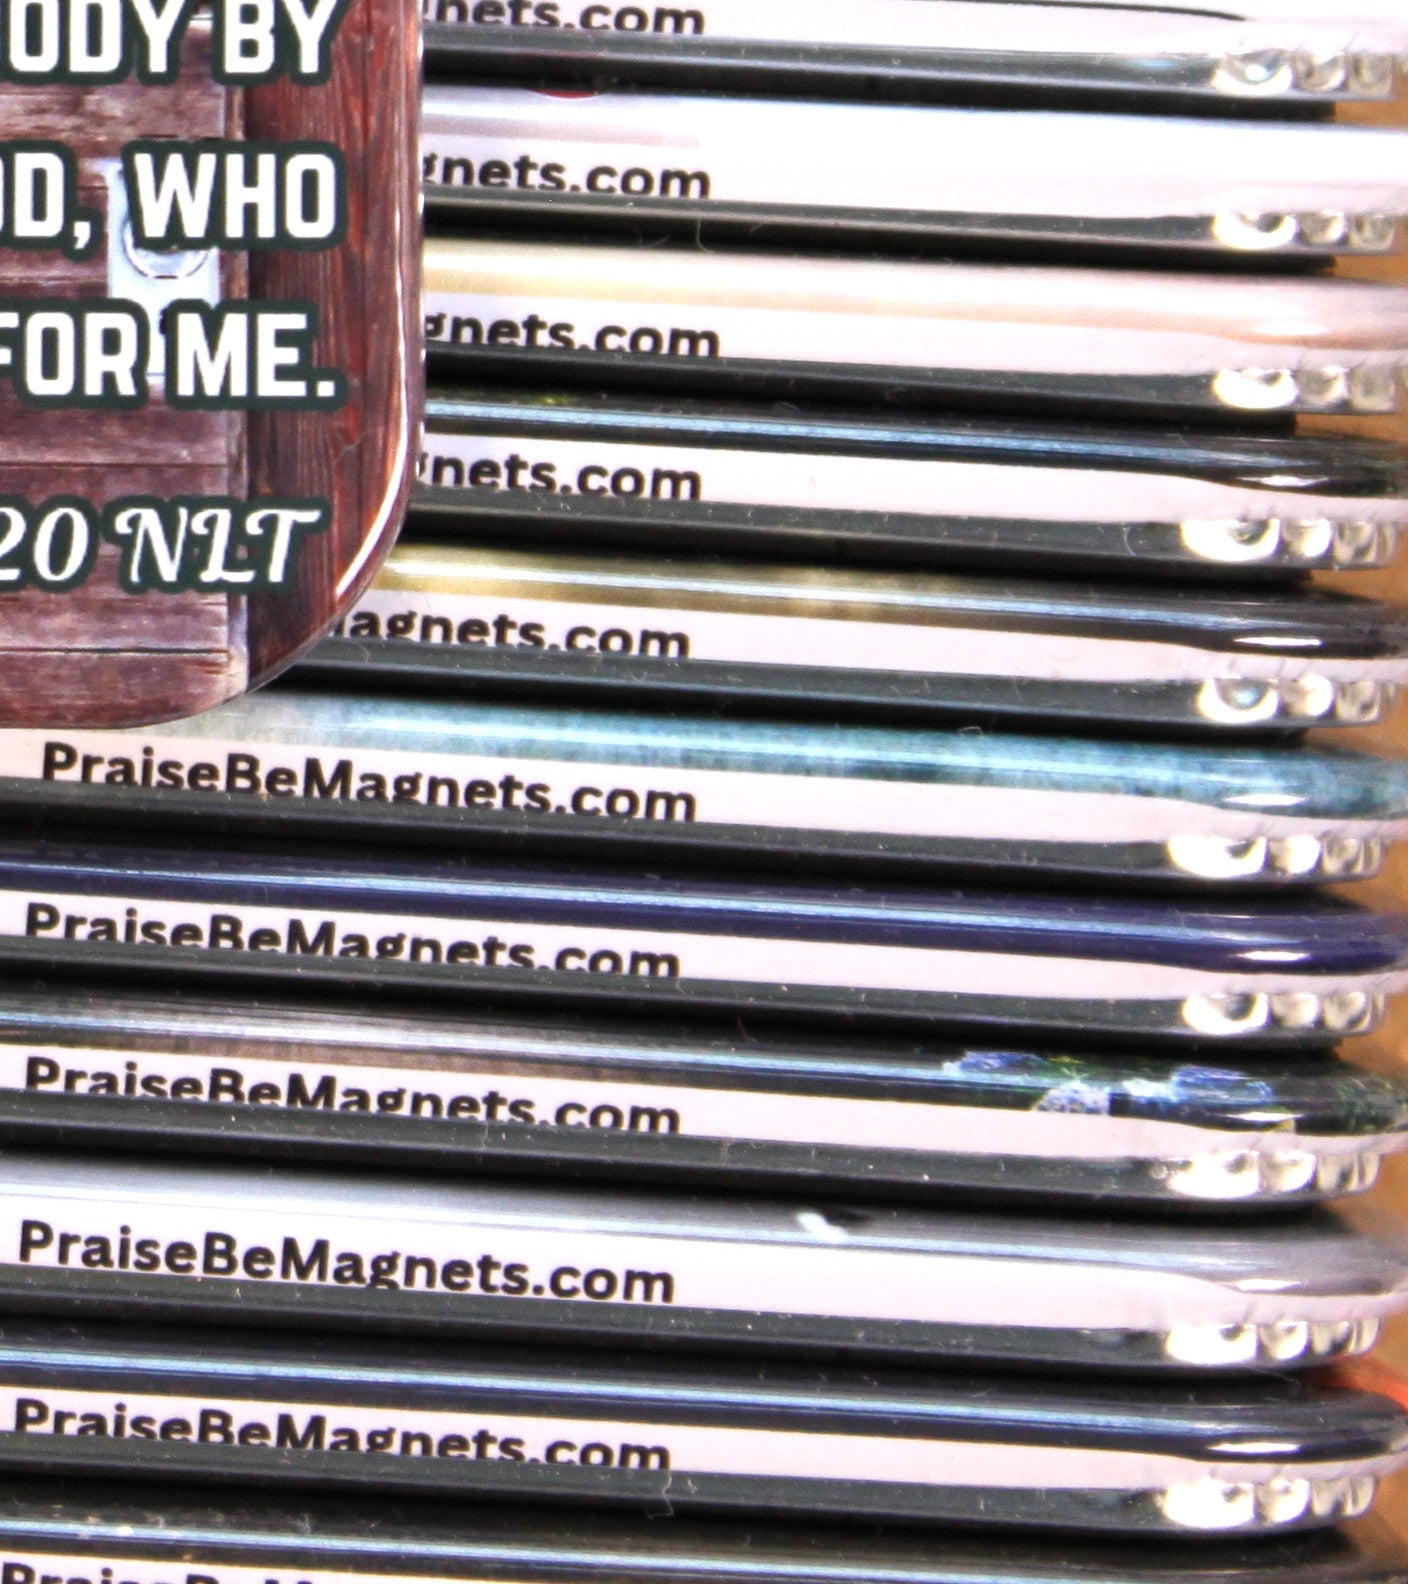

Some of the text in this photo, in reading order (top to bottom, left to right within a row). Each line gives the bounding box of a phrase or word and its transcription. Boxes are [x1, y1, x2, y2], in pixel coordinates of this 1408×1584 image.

[133, 152, 336, 239] WHO
[176, 312, 335, 398] ME.
[113, 506, 321, 584] NLT
[42, 741, 697, 822] PraiseBeMagnets.com
[19, 1219, 675, 1303] PraiseBeMagnets.com
